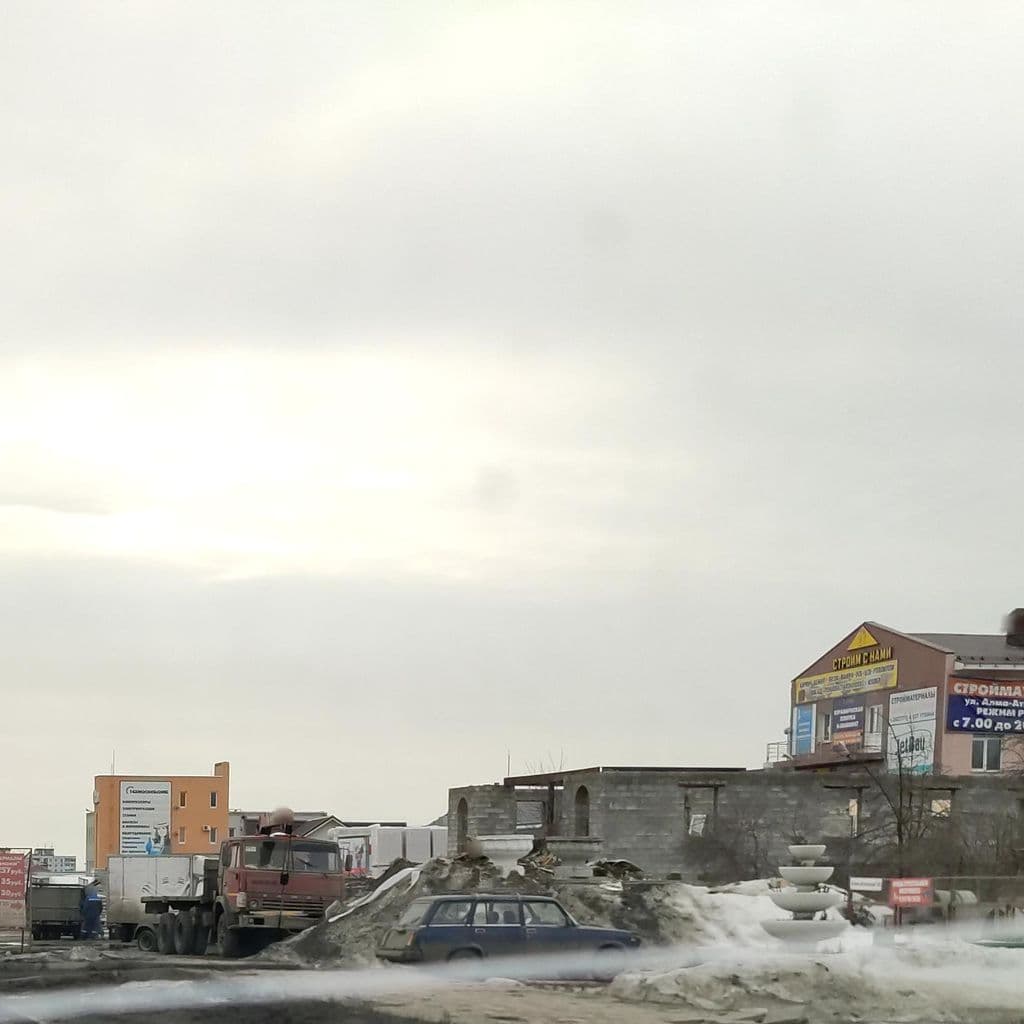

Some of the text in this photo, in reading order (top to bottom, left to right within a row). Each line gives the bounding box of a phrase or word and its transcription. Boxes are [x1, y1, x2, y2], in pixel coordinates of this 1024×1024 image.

[832, 653, 862, 669] СТРОИМ
[869, 647, 893, 661] НАМИ
[954, 682, 1024, 696] СТРОЙМА
[976, 707, 1016, 716] РЕЖИМ
[962, 717, 993, 729] 7.00
[994, 721, 1012, 731] до
[1014, 719, 1024, 730] 2
